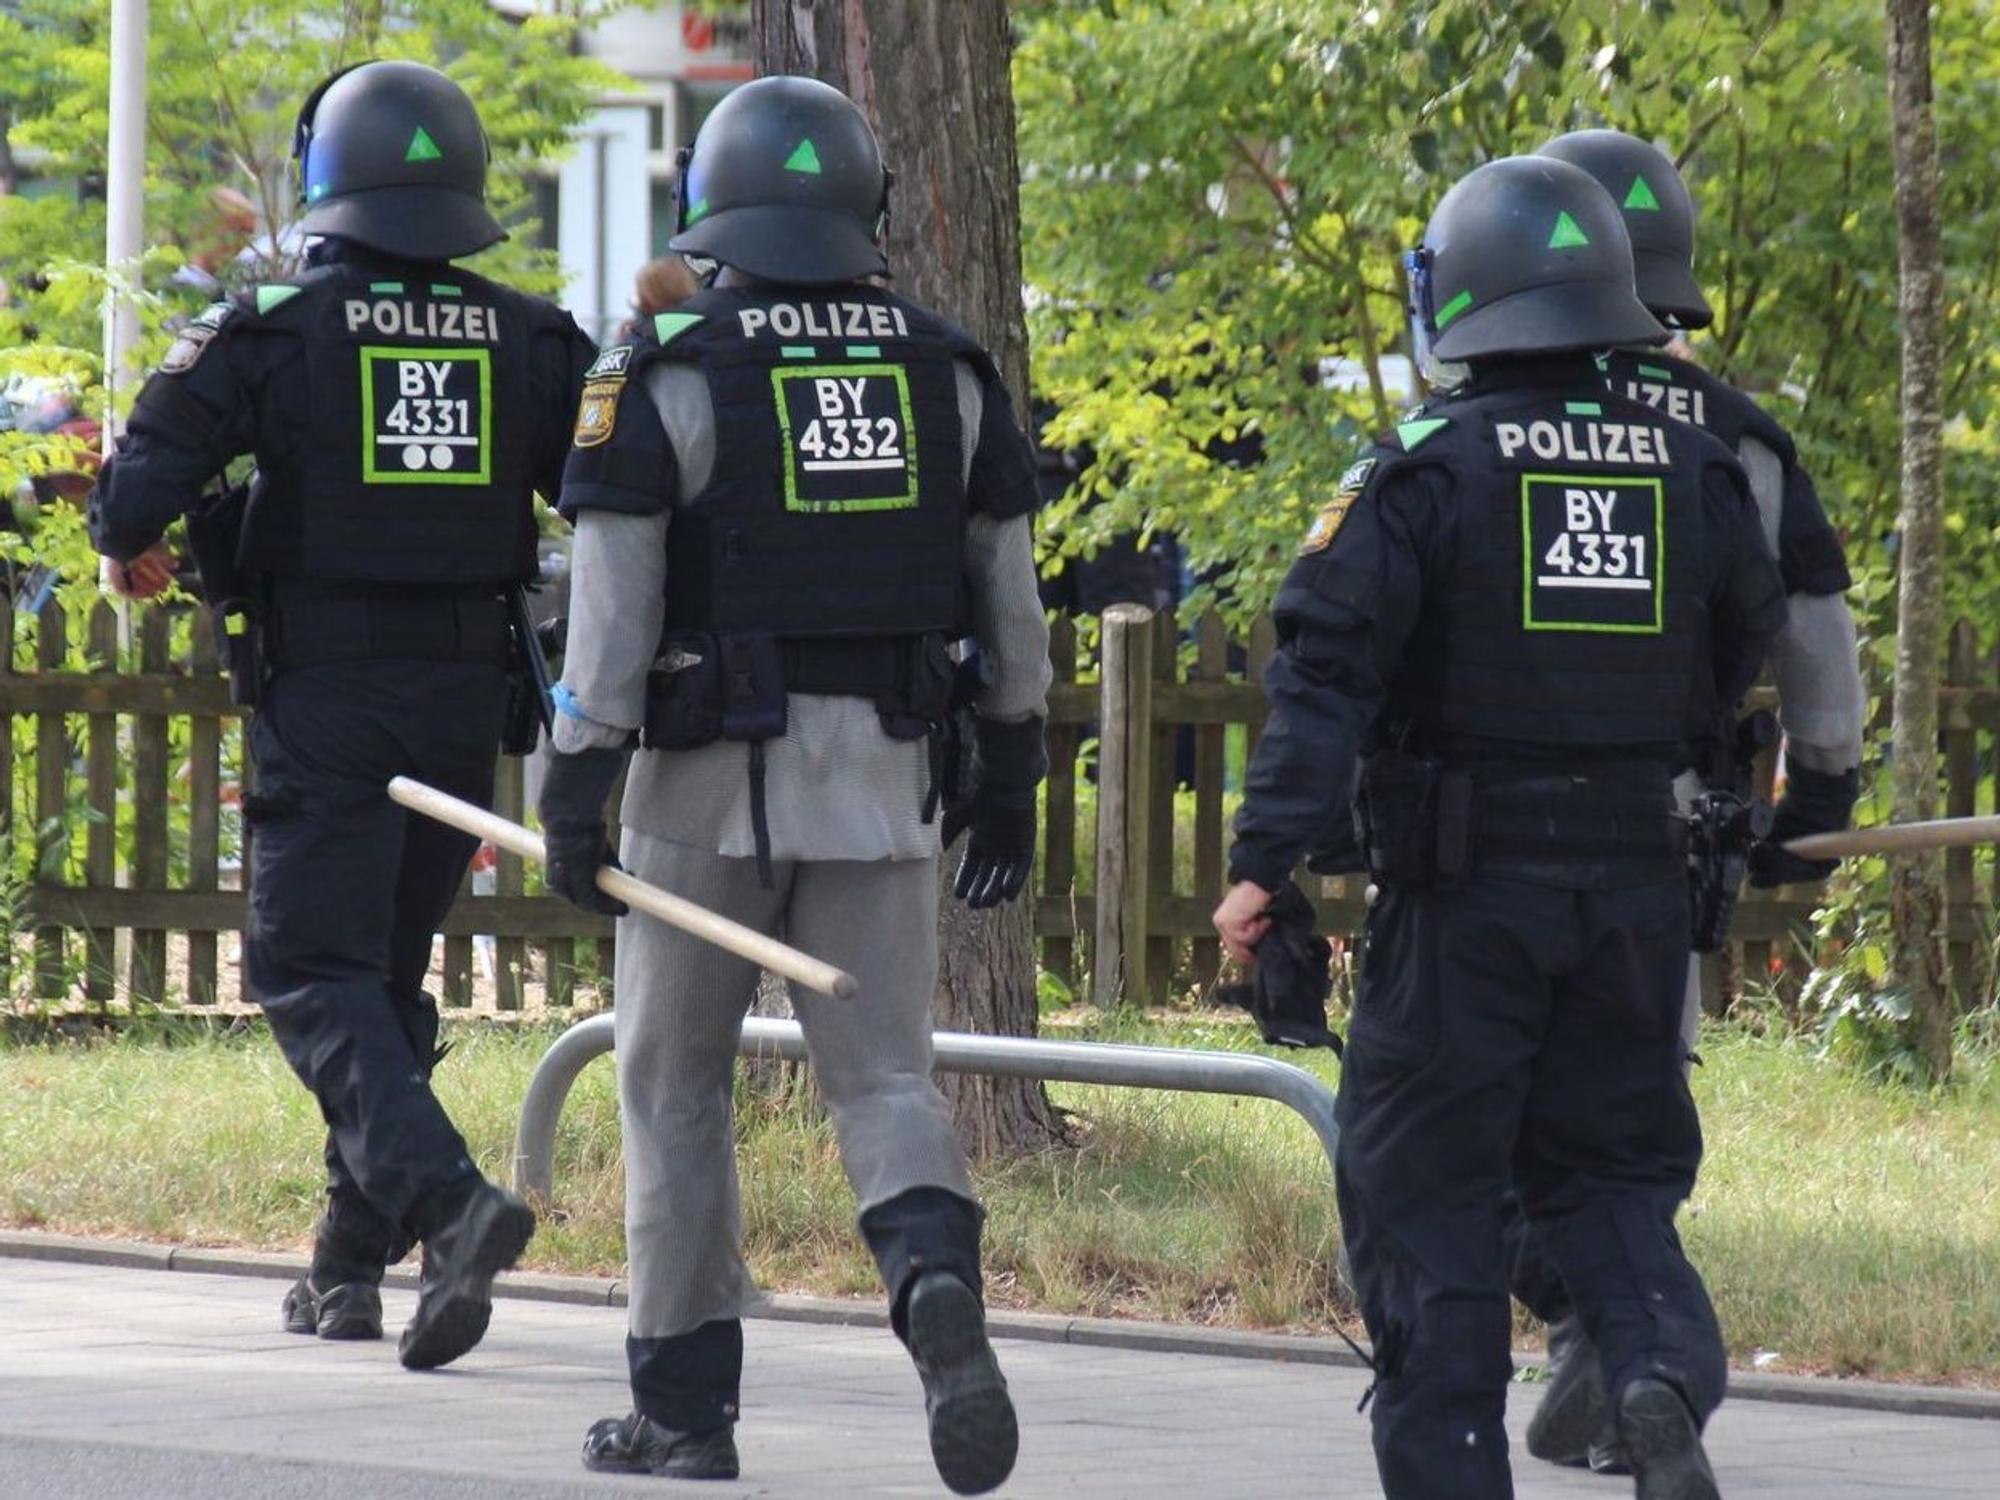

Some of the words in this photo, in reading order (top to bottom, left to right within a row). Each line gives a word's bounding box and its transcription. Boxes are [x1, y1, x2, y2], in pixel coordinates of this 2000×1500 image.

[344, 299, 499, 341] POLIZEI
[737, 302, 909, 338] POLIZEI
[398, 360, 452, 397] BY
[814, 377, 867, 417] BY
[385, 398, 469, 435] 4331
[799, 416, 900, 459] 4332
[1495, 420, 1670, 465] POLIZEI
[1564, 488, 1617, 532] BY
[1544, 532, 1646, 577] 4331
